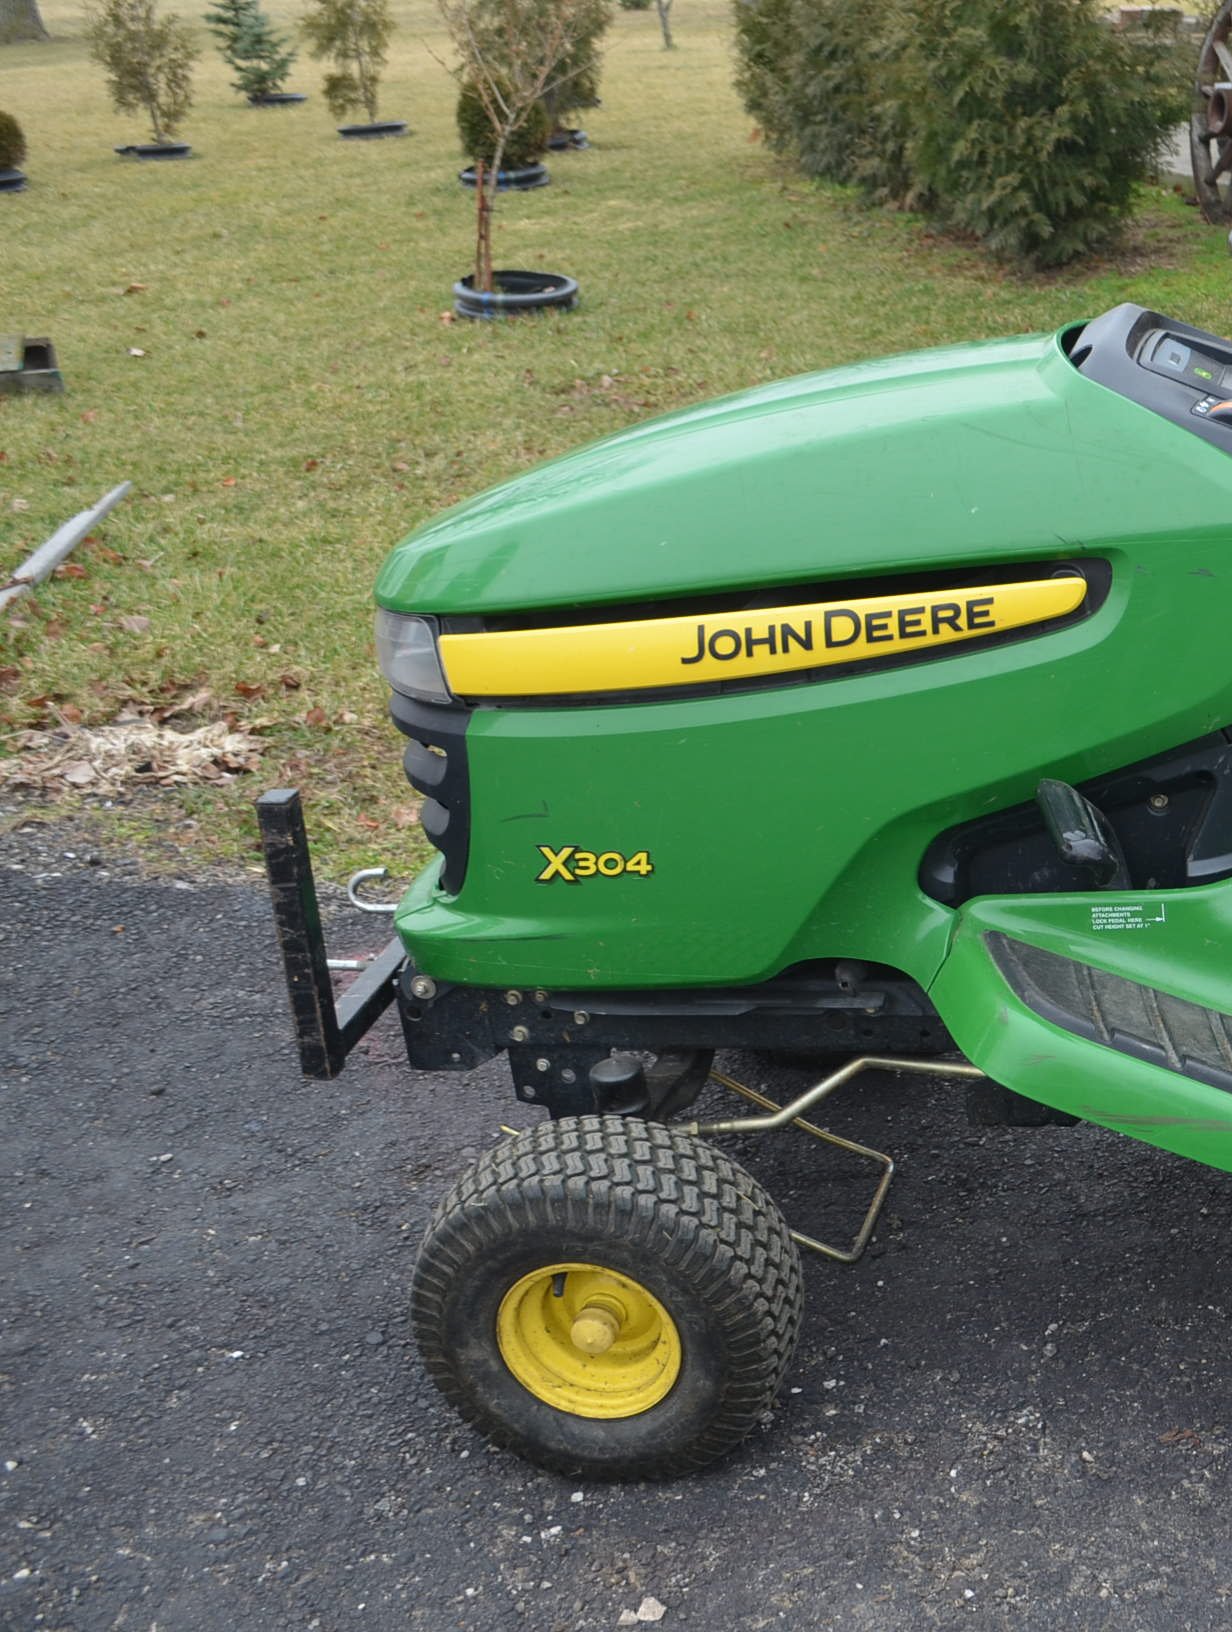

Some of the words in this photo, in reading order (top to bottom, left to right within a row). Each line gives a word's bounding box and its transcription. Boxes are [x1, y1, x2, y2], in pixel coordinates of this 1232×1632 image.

[681, 619, 814, 665] JOHN
[823, 596, 996, 649] DEERE
[535, 845, 653, 882] X304
